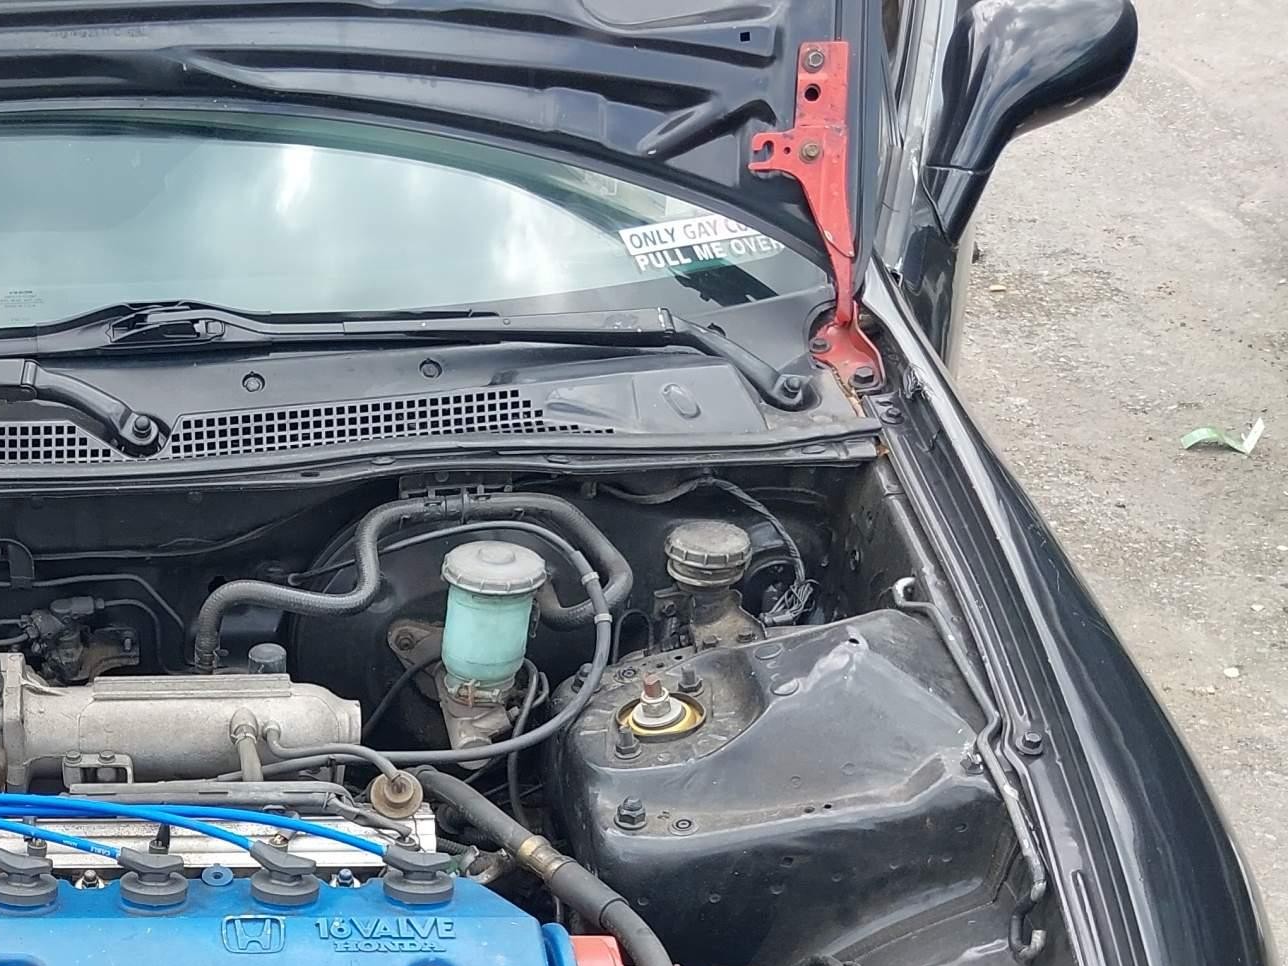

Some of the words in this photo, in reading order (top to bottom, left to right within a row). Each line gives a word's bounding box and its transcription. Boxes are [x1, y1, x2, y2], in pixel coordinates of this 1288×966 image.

[629, 227, 676, 249] ONLY
[683, 219, 722, 241] GAY
[635, 249, 692, 271] PULL
[692, 243, 727, 261] ME
[334, 941, 446, 953] HONDA
